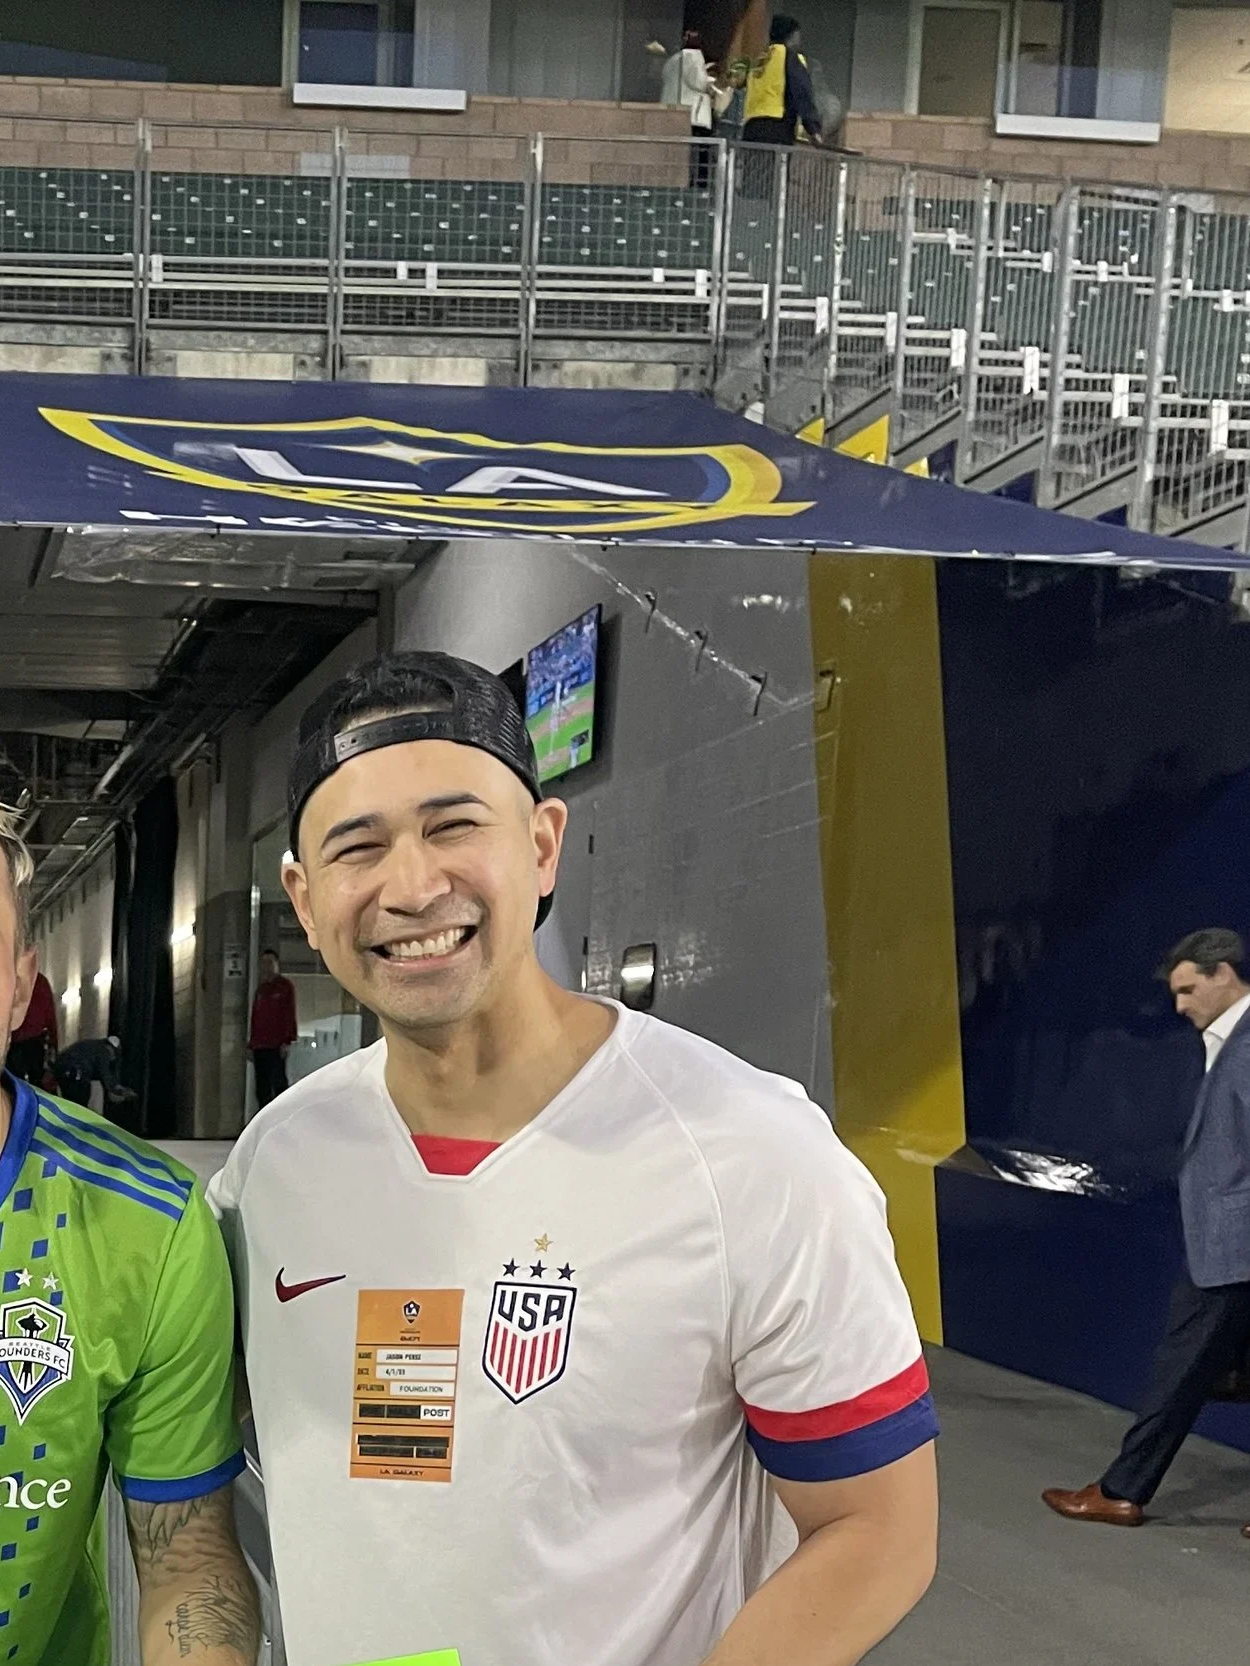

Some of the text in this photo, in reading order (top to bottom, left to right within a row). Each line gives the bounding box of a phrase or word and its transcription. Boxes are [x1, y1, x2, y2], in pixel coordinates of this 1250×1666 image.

[234, 445, 672, 496] LA
[497, 1289, 567, 1332] USA
[53, 1355, 66, 1369] FC
[399, 1385, 443, 1393] FOUNDATION
[423, 1408, 450, 1417] POST
